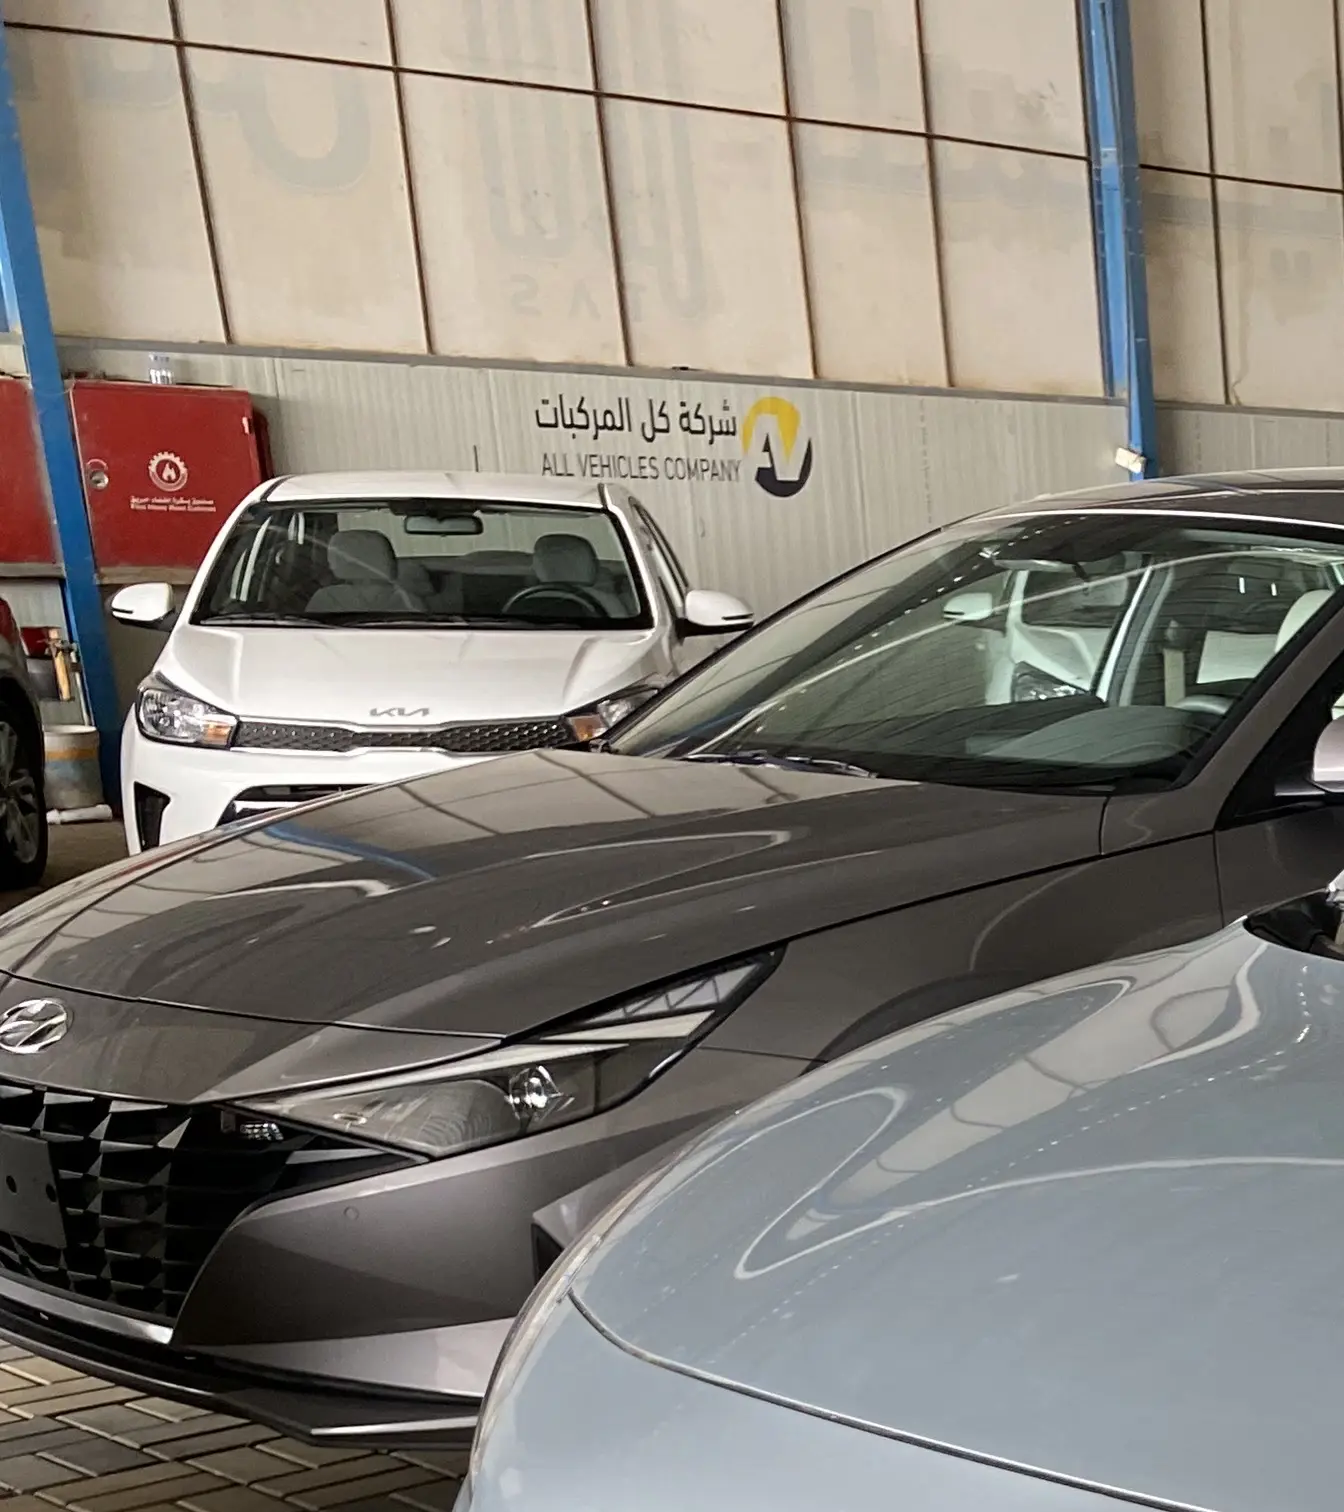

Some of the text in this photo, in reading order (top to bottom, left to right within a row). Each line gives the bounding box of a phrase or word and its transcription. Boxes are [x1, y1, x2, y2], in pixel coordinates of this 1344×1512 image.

[535, 394, 736, 445] شركة كل المركبات
[541, 453, 742, 482] ALL VEHICLES COMPANY
